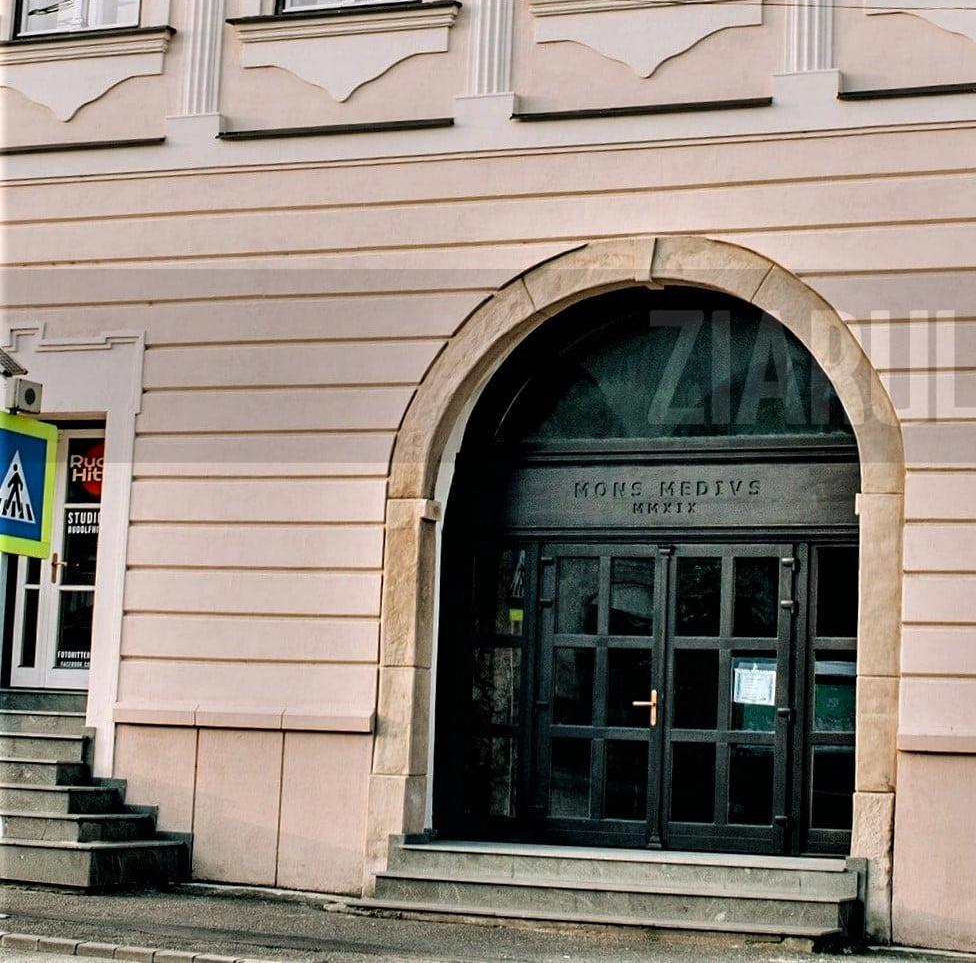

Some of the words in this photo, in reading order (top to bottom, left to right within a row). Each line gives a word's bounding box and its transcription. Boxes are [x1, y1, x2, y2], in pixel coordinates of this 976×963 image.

[574, 481, 643, 498] MONS
[659, 480, 761, 496] MEDIVS
[632, 502, 697, 514] MMXIX
